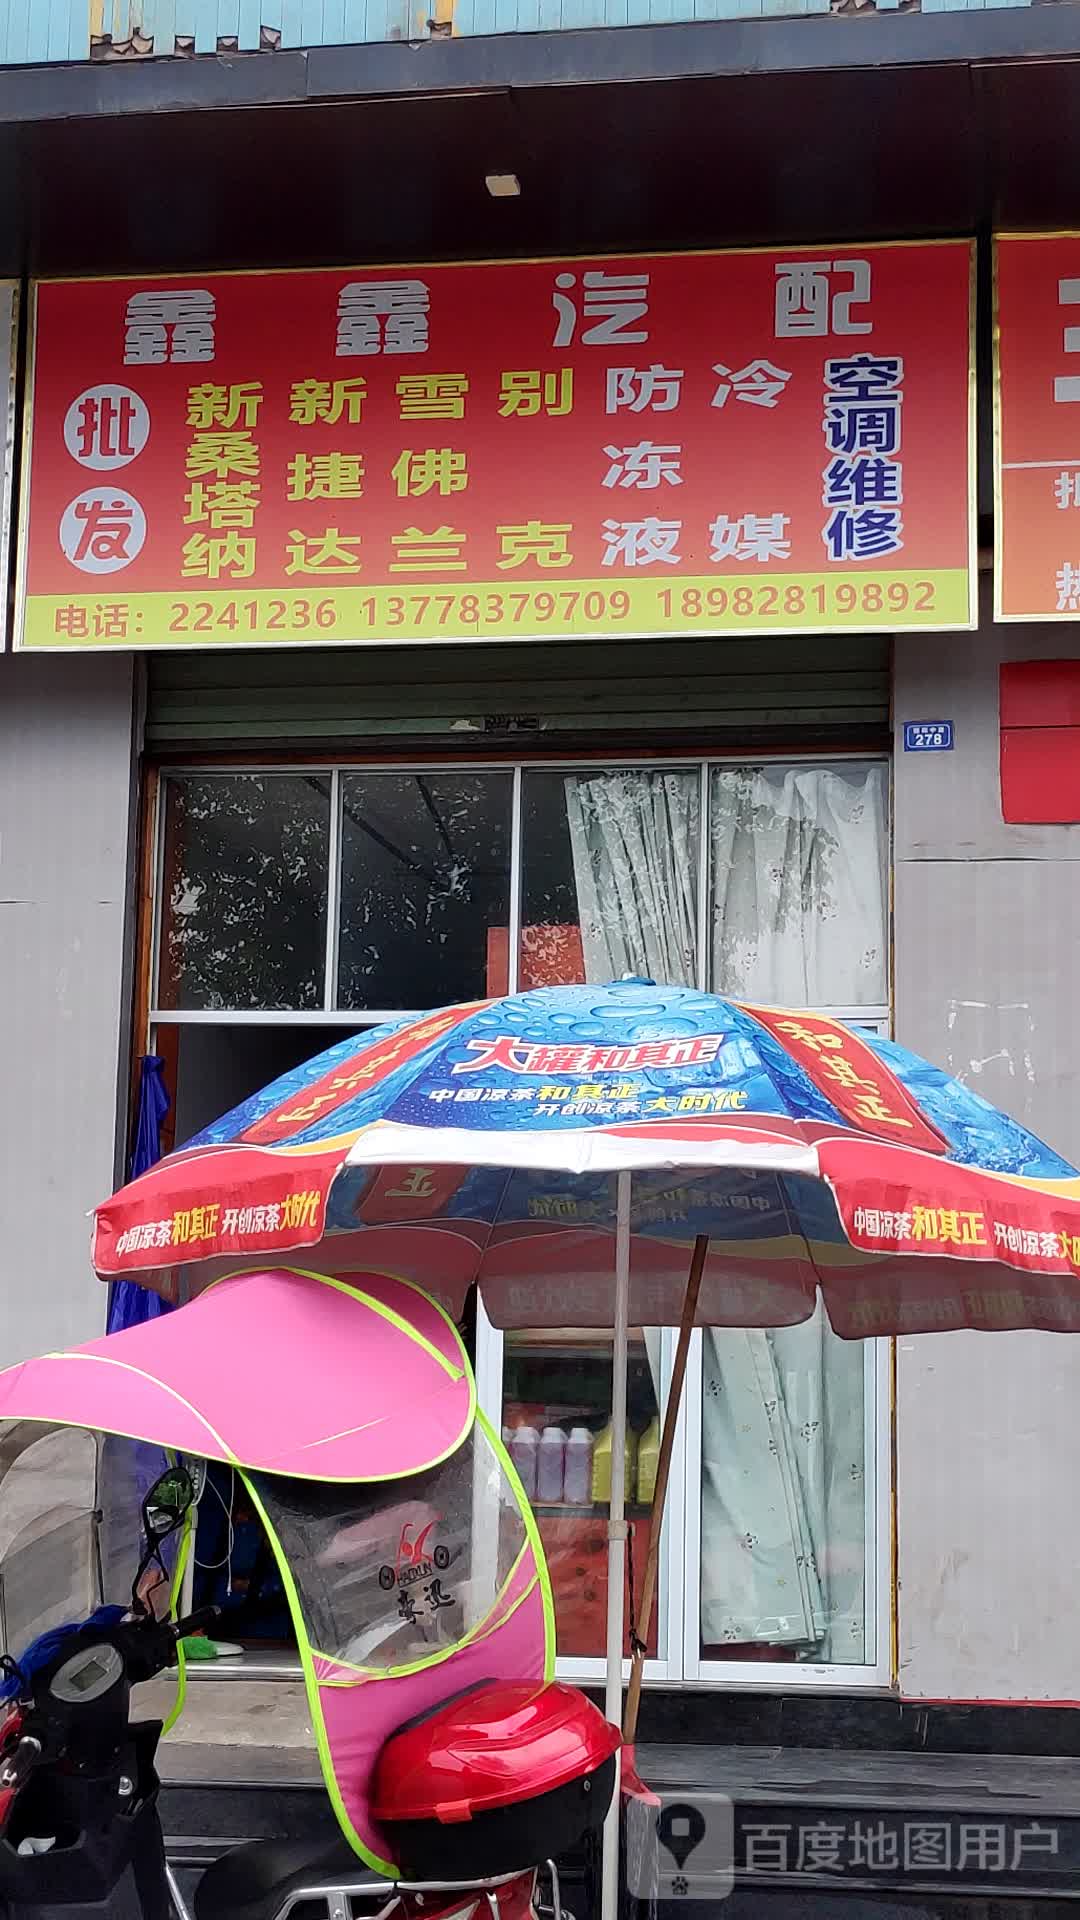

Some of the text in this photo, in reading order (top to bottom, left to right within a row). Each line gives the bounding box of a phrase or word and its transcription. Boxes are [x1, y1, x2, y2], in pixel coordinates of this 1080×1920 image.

[123, 260, 873, 365] 鑫鑫汽配
[72, 396, 138, 562] 批发
[181, 381, 264, 579] 新桑塔纳
[285, 377, 367, 576] 新捷达
[389, 372, 470, 573] 雪佛兰
[495, 367, 574, 569] 别克
[601, 364, 684, 568] 防冻液
[709, 359, 793, 563] 冷媒
[825, 354, 903, 561] 空调维修
[168, 598, 337, 632] 2241236
[361, 591, 632, 626] 13778379709
[657, 582, 936, 618] 18982819892
[915, 733, 942, 746] 278
[452, 1034, 724, 1074] 大罐和其正
[773, 1020, 914, 1128] 和其正
